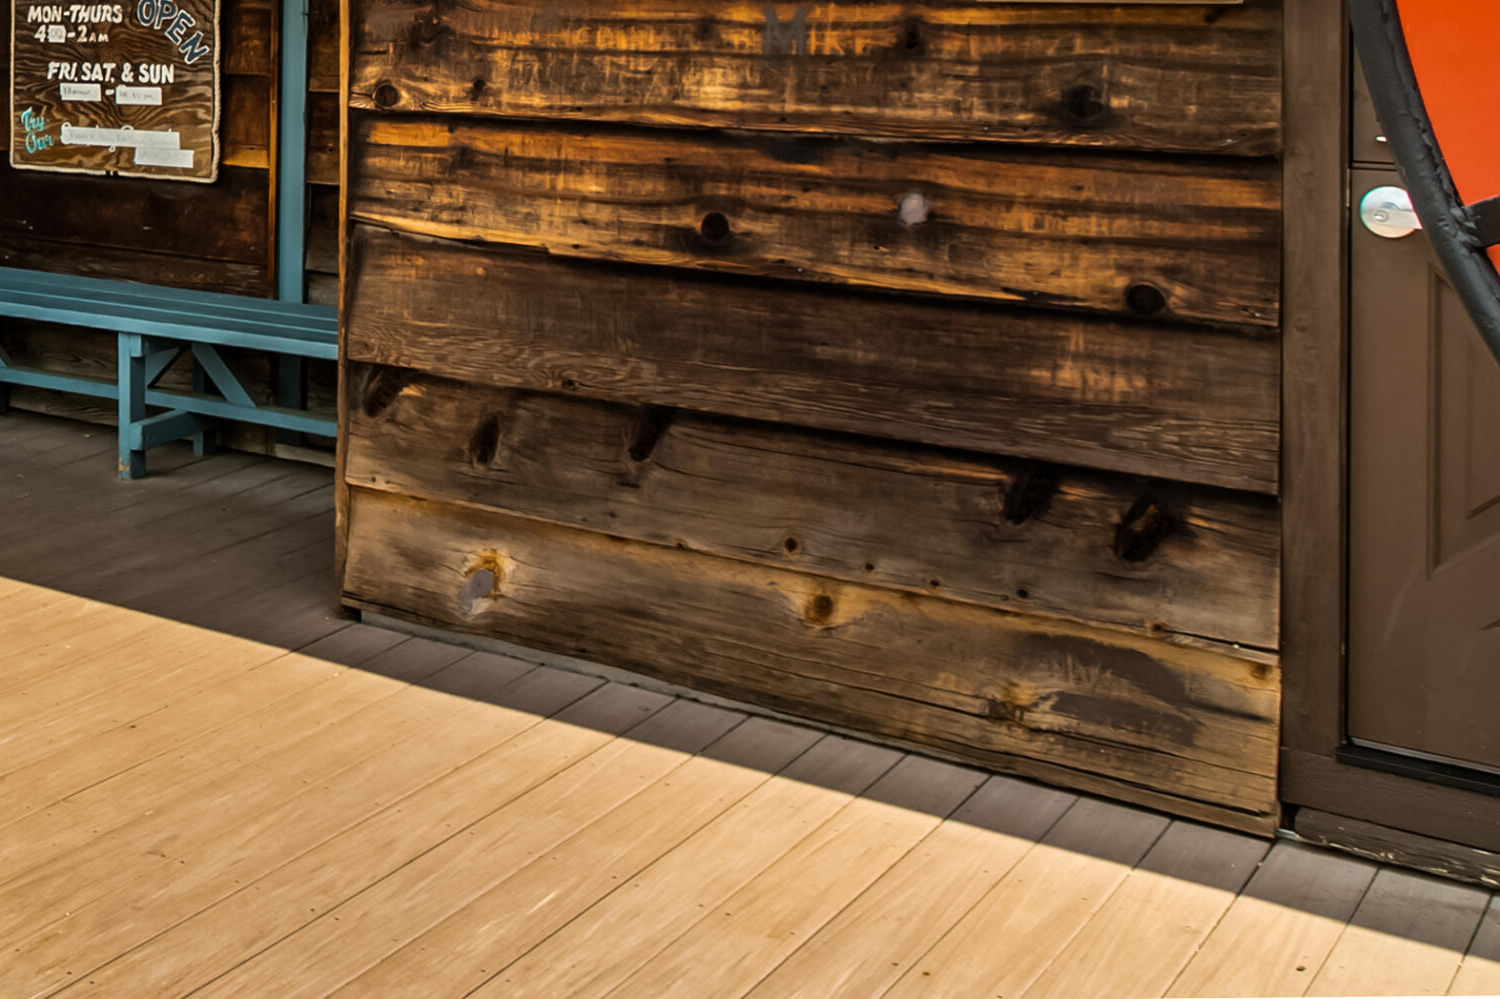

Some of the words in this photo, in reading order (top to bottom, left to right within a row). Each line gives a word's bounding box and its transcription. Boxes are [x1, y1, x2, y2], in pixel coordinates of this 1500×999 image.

[27, 4, 123, 24] MON-THURS
[121, 62, 134, 82] &
[138, 63, 175, 84] SUN
[21, 106, 45, 132] Try
[25, 131, 54, 154] Our
